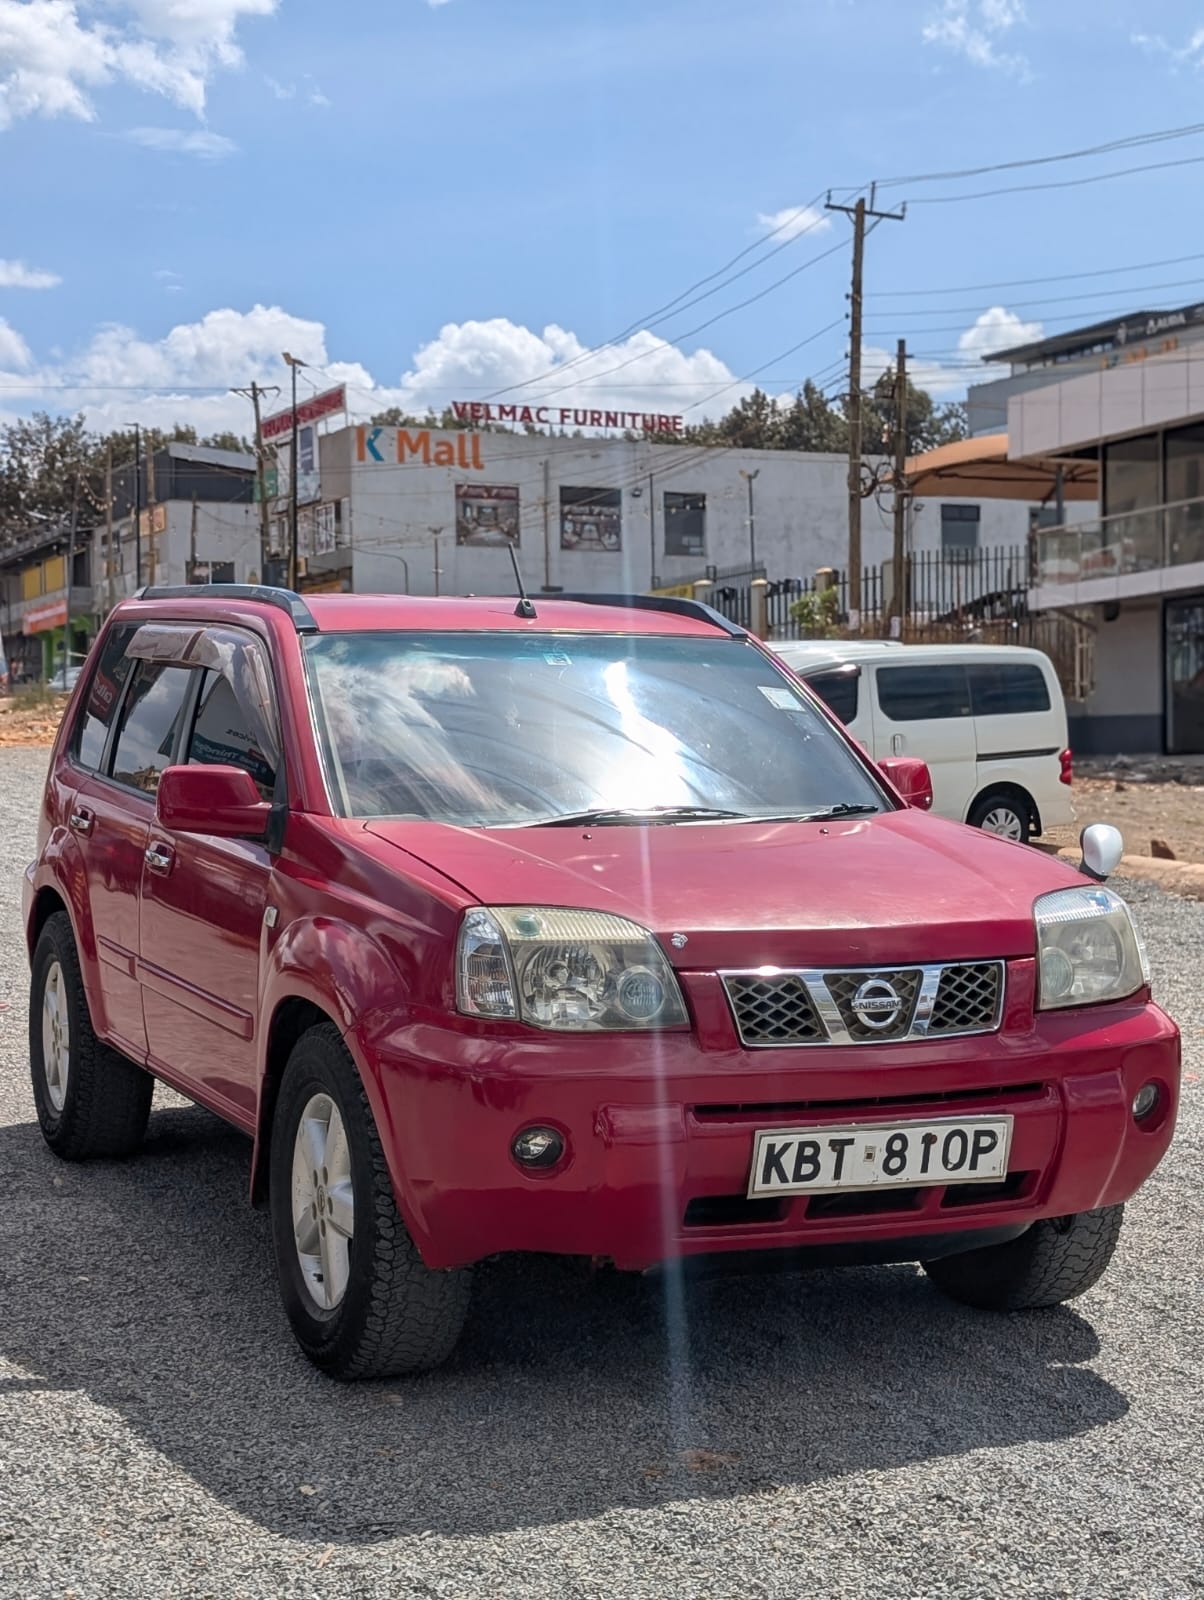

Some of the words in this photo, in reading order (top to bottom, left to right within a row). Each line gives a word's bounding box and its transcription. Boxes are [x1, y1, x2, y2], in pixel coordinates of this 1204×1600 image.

[452, 401, 549, 424] VELMAC
[560, 408, 683, 432] FURNITURE
[356, 426, 385, 462] K
[396, 429, 484, 470] Mall
[859, 1000, 900, 1010] NISSAN
[762, 1138, 855, 1185] KBT
[882, 1129, 998, 1176] 810P
